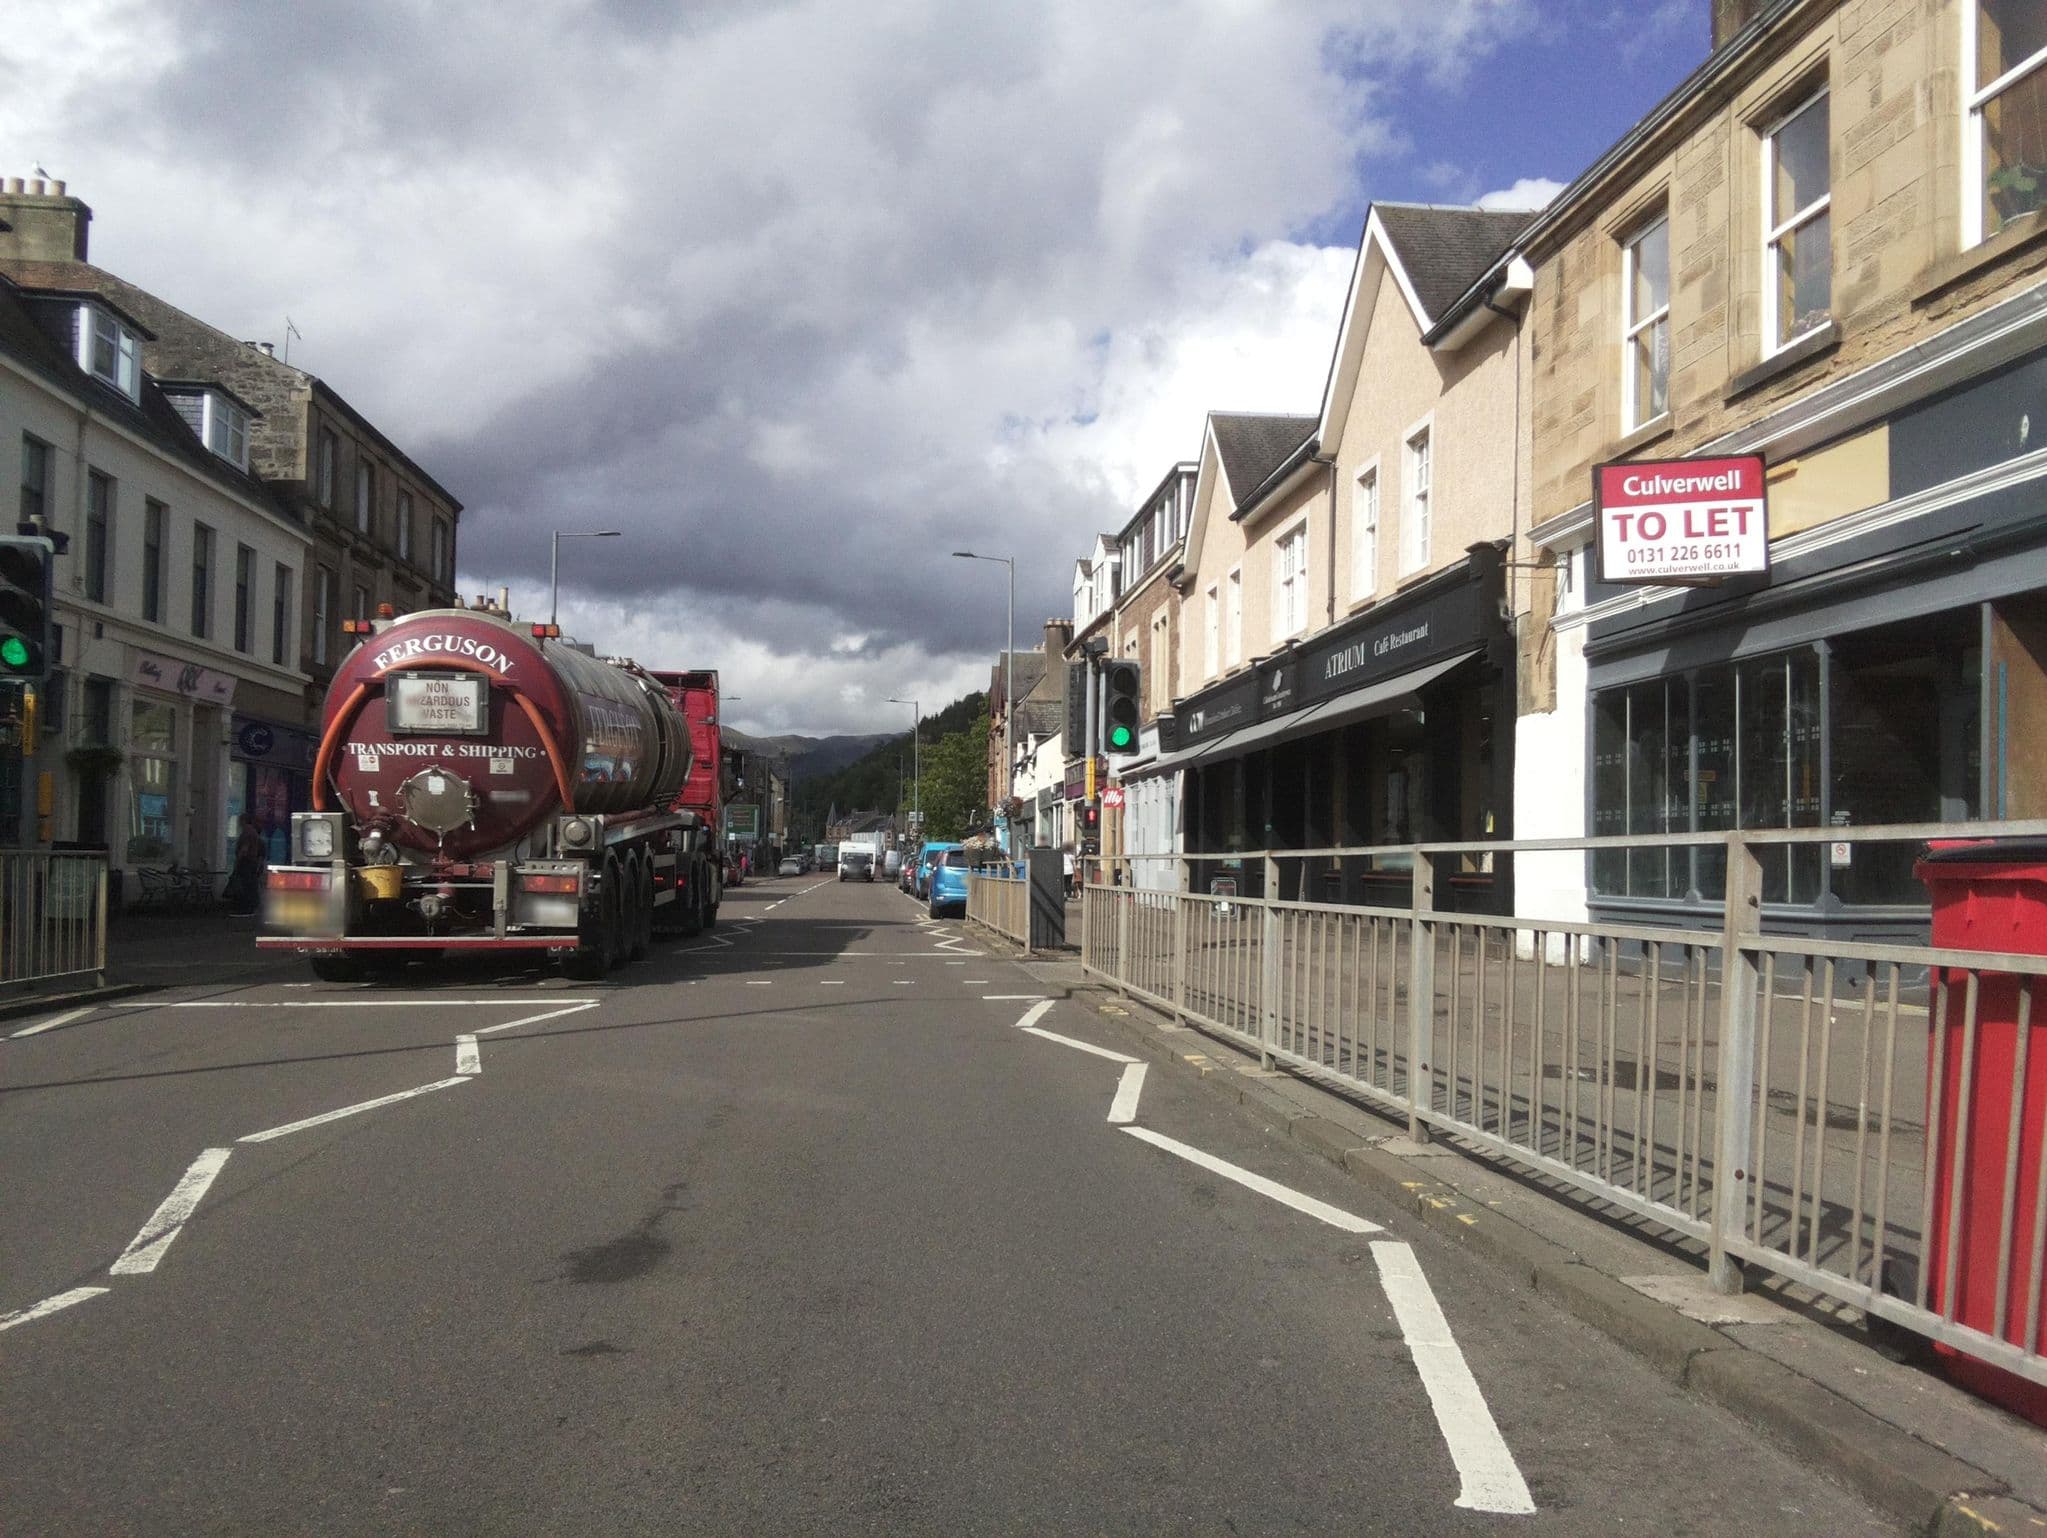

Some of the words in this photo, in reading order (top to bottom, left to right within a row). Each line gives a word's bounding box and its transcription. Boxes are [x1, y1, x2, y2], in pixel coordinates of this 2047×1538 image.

[1623, 470, 1741, 496] Culverwell
[1612, 511, 1667, 542] TO
[1684, 506, 1754, 538] LET
[1627, 548, 1664, 563] 0131
[1671, 546, 1698, 561] 226
[1704, 543, 1741, 559] 6611
[1629, 562, 1739, 575] www.culverwell.co.uk
[373, 634, 515, 674] FERGUSON
[1324, 642, 1365, 680] ATRIUM
[1374, 636, 1389, 657] Café
[1390, 621, 1429, 650] Restaurant
[426, 682, 448, 693] NON
[407, 696, 470, 707] ZARDOUS
[348, 742, 438, 757] TRANSPORT
[442, 744, 455, 757] &
[459, 745, 537, 759] SHIPPING
[1104, 790, 1123, 806] illy
